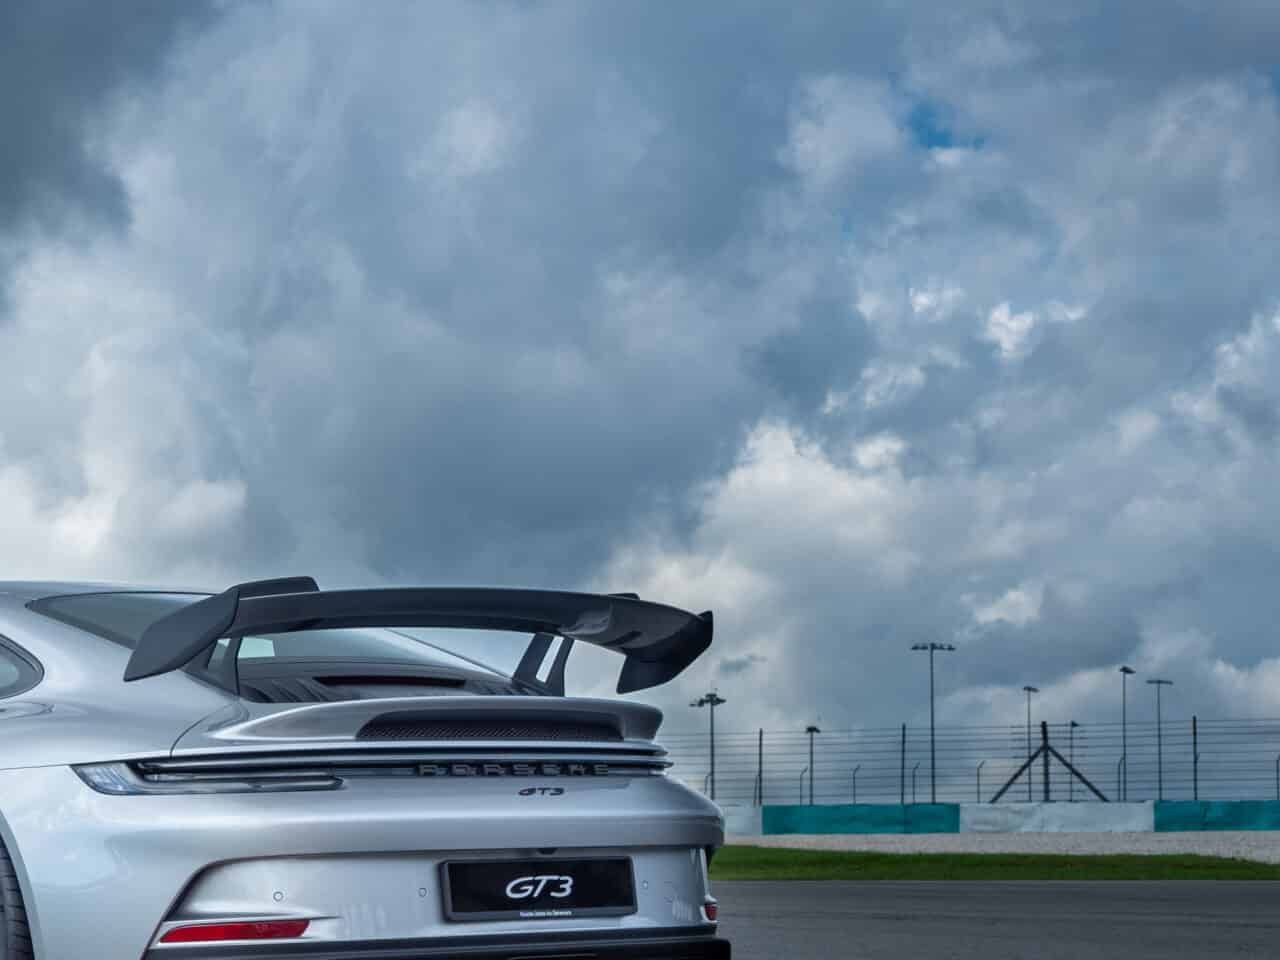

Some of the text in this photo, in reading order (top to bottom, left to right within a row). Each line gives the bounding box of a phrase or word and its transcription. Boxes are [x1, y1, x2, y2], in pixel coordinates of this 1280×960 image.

[420, 764, 608, 776] PORSCHE
[518, 787, 565, 796] GT3
[506, 875, 573, 899] GT3
